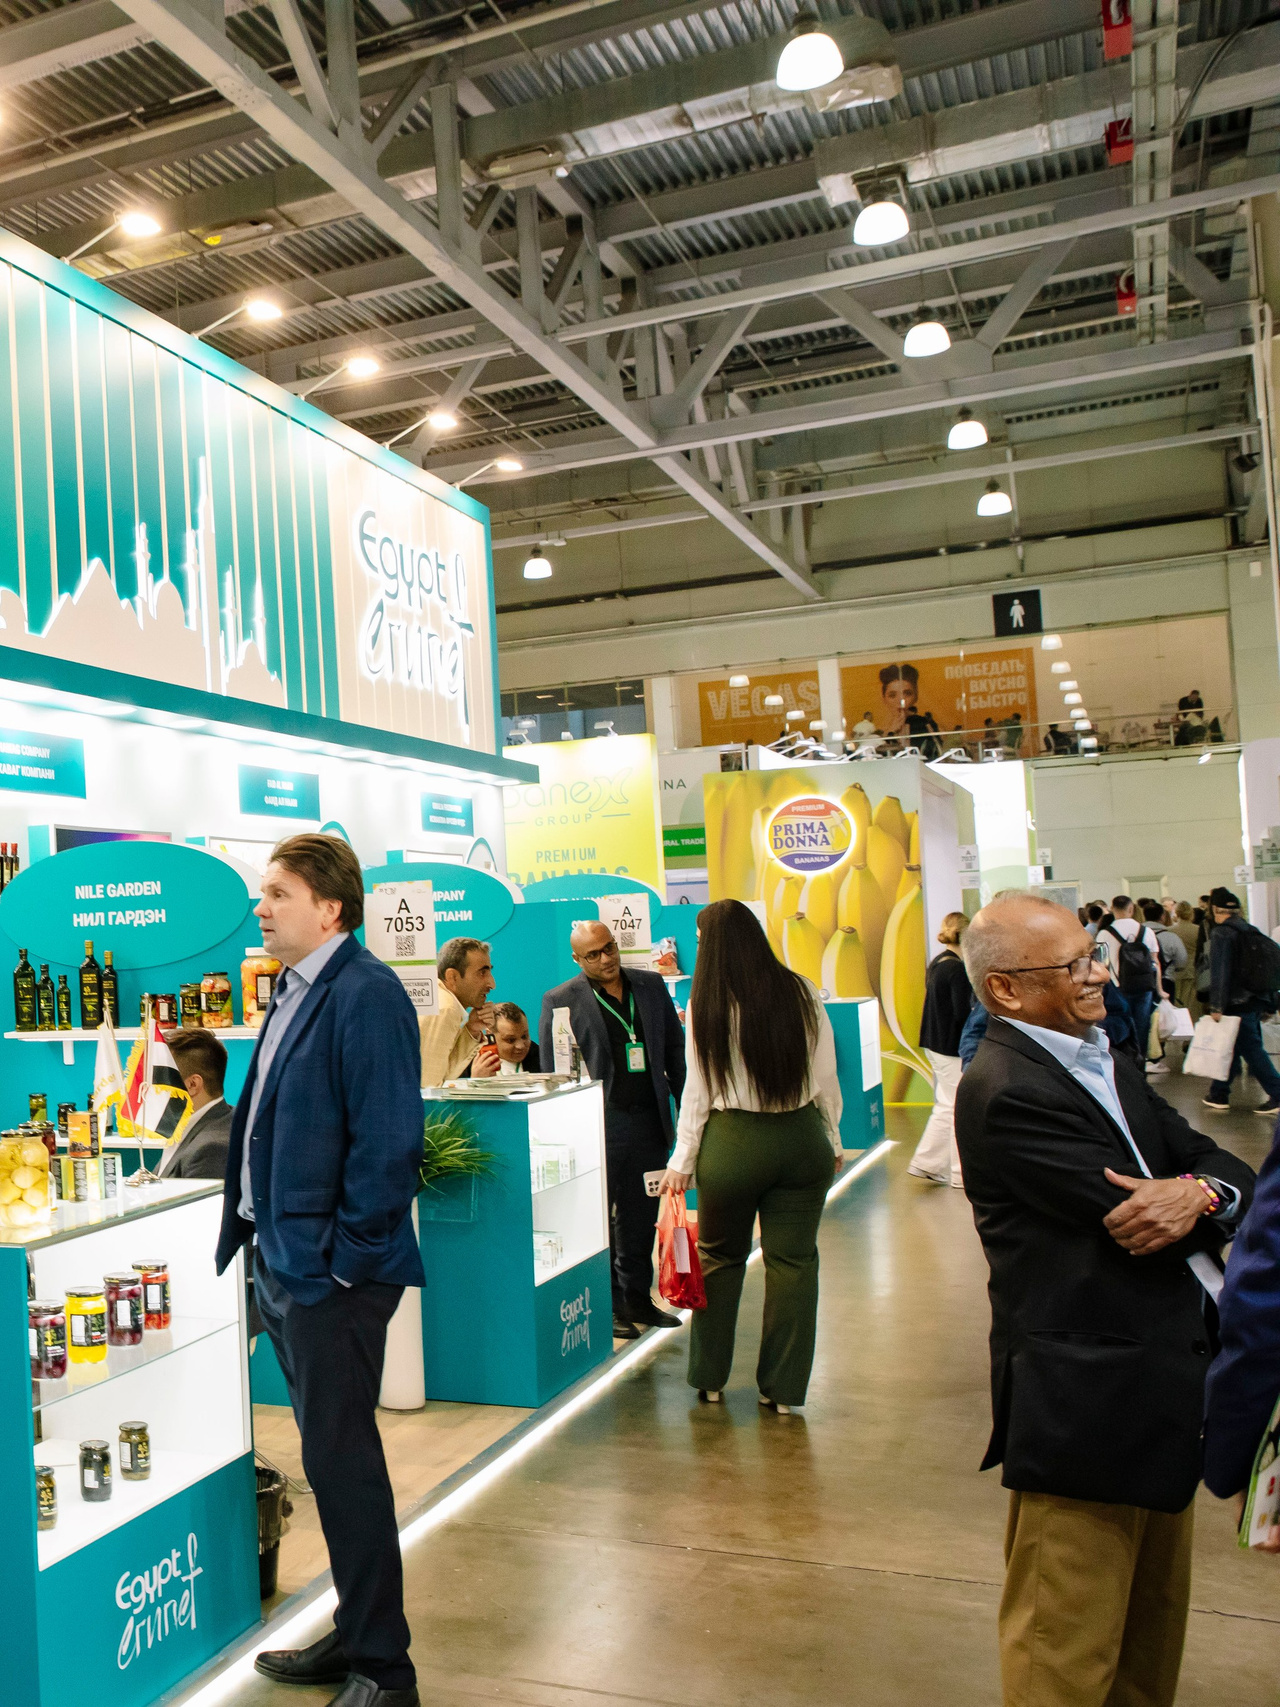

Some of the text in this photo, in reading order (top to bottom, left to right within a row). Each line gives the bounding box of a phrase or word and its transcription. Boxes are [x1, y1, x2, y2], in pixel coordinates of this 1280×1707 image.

[358, 510, 447, 610] Egypt
[970, 675, 1027, 693] ВКУСНО
[969, 692, 1027, 709] БЫСТРО
[21, 743, 51, 760] COMPANY
[791, 803, 825, 812] PREMIUM
[535, 813, 593, 826] GROUP
[772, 821, 829, 837] PRIMA
[773, 834, 831, 850] DONNA
[536, 847, 596, 863] PREMIUM
[794, 856, 830, 865] BANANAS
[75, 881, 162, 900] NILE GARDEN
[397, 898, 411, 914] A
[622, 906, 632, 917] A
[72, 908, 166, 928] НИЛ ГАРДЭН
[384, 916, 425, 933] 7053
[612, 918, 642, 931] 7047
[560, 1293, 584, 1327] Egypt
[115, 1548, 182, 1615] Egypt
